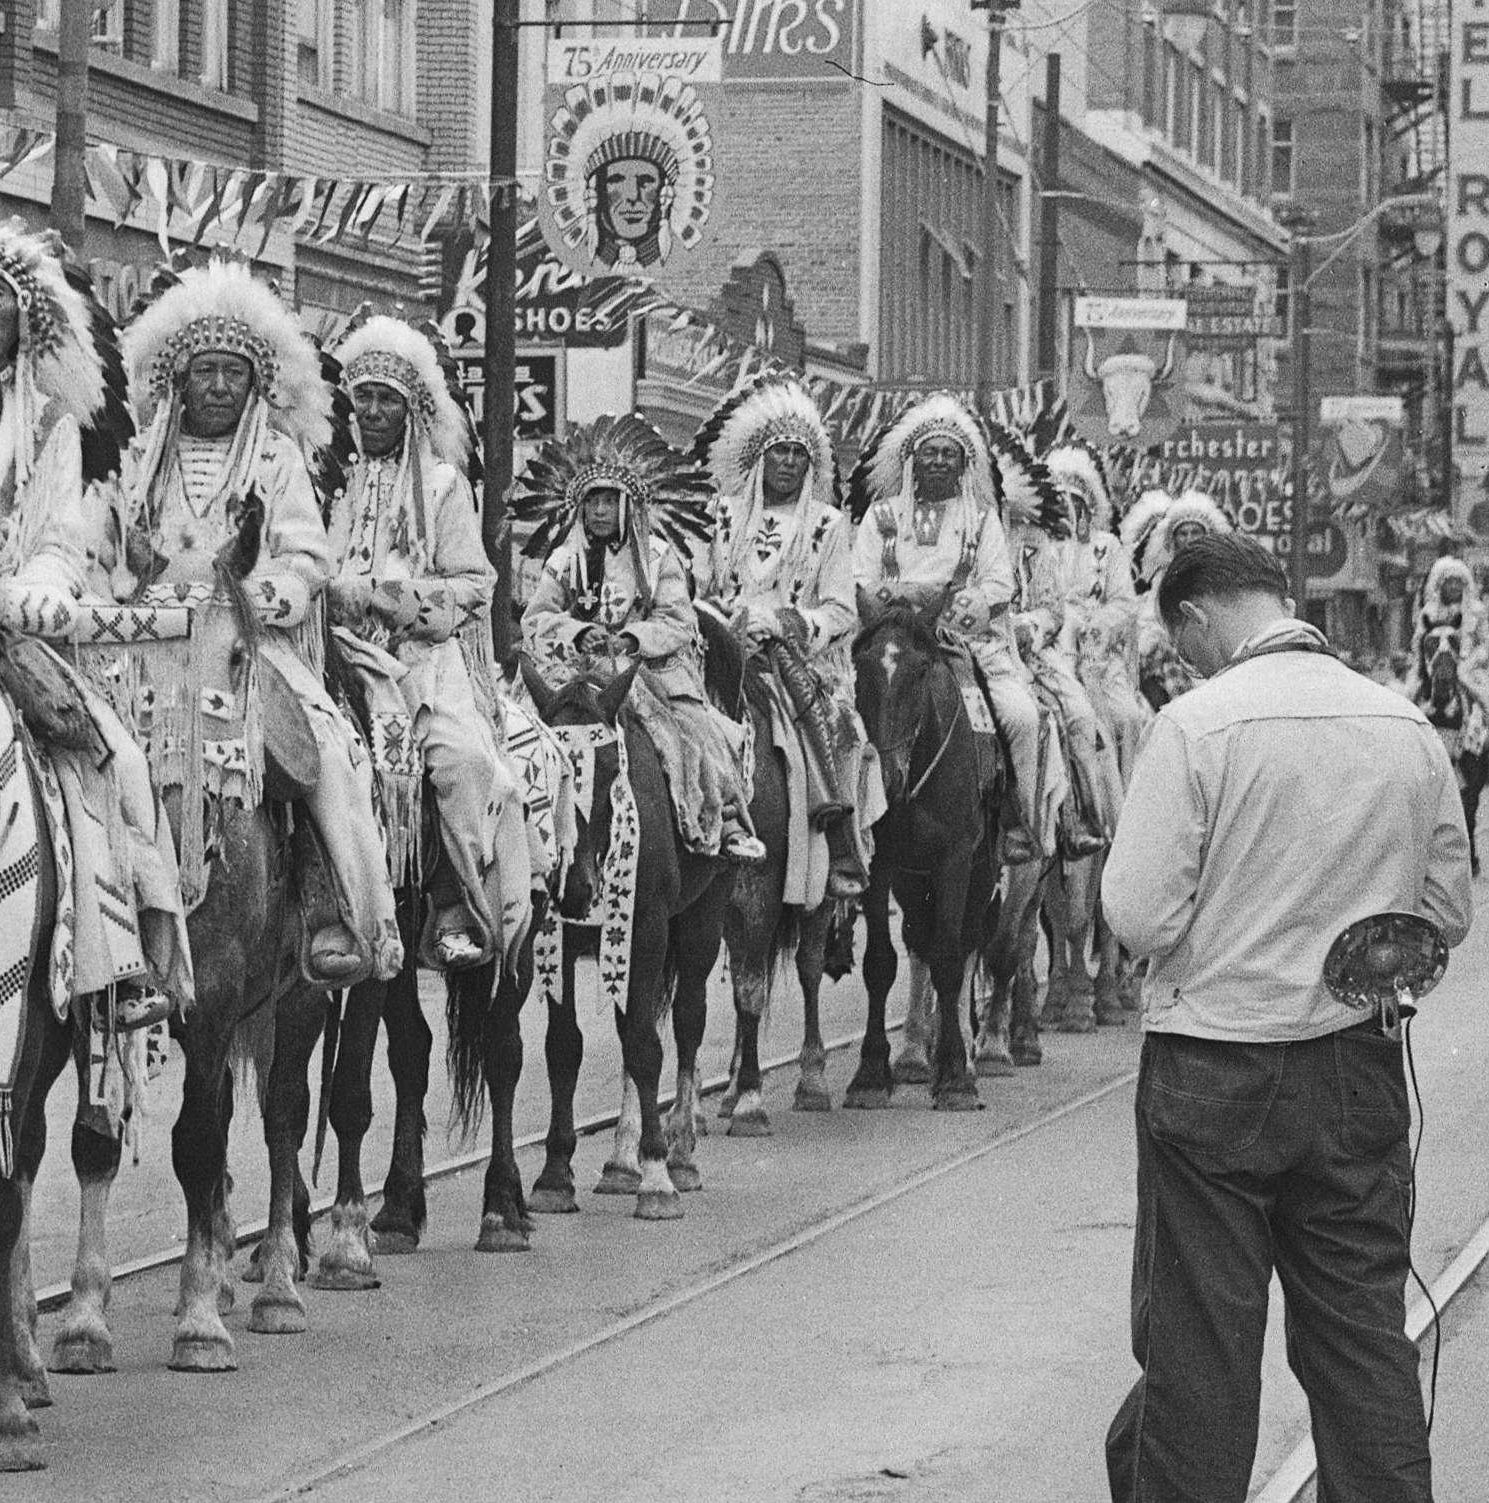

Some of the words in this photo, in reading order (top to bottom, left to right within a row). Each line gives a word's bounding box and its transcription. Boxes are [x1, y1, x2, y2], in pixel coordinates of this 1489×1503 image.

[596, 45, 708, 75] Anniversary
[1163, 428, 1272, 458] rchester
[1238, 499, 1291, 531] OES
